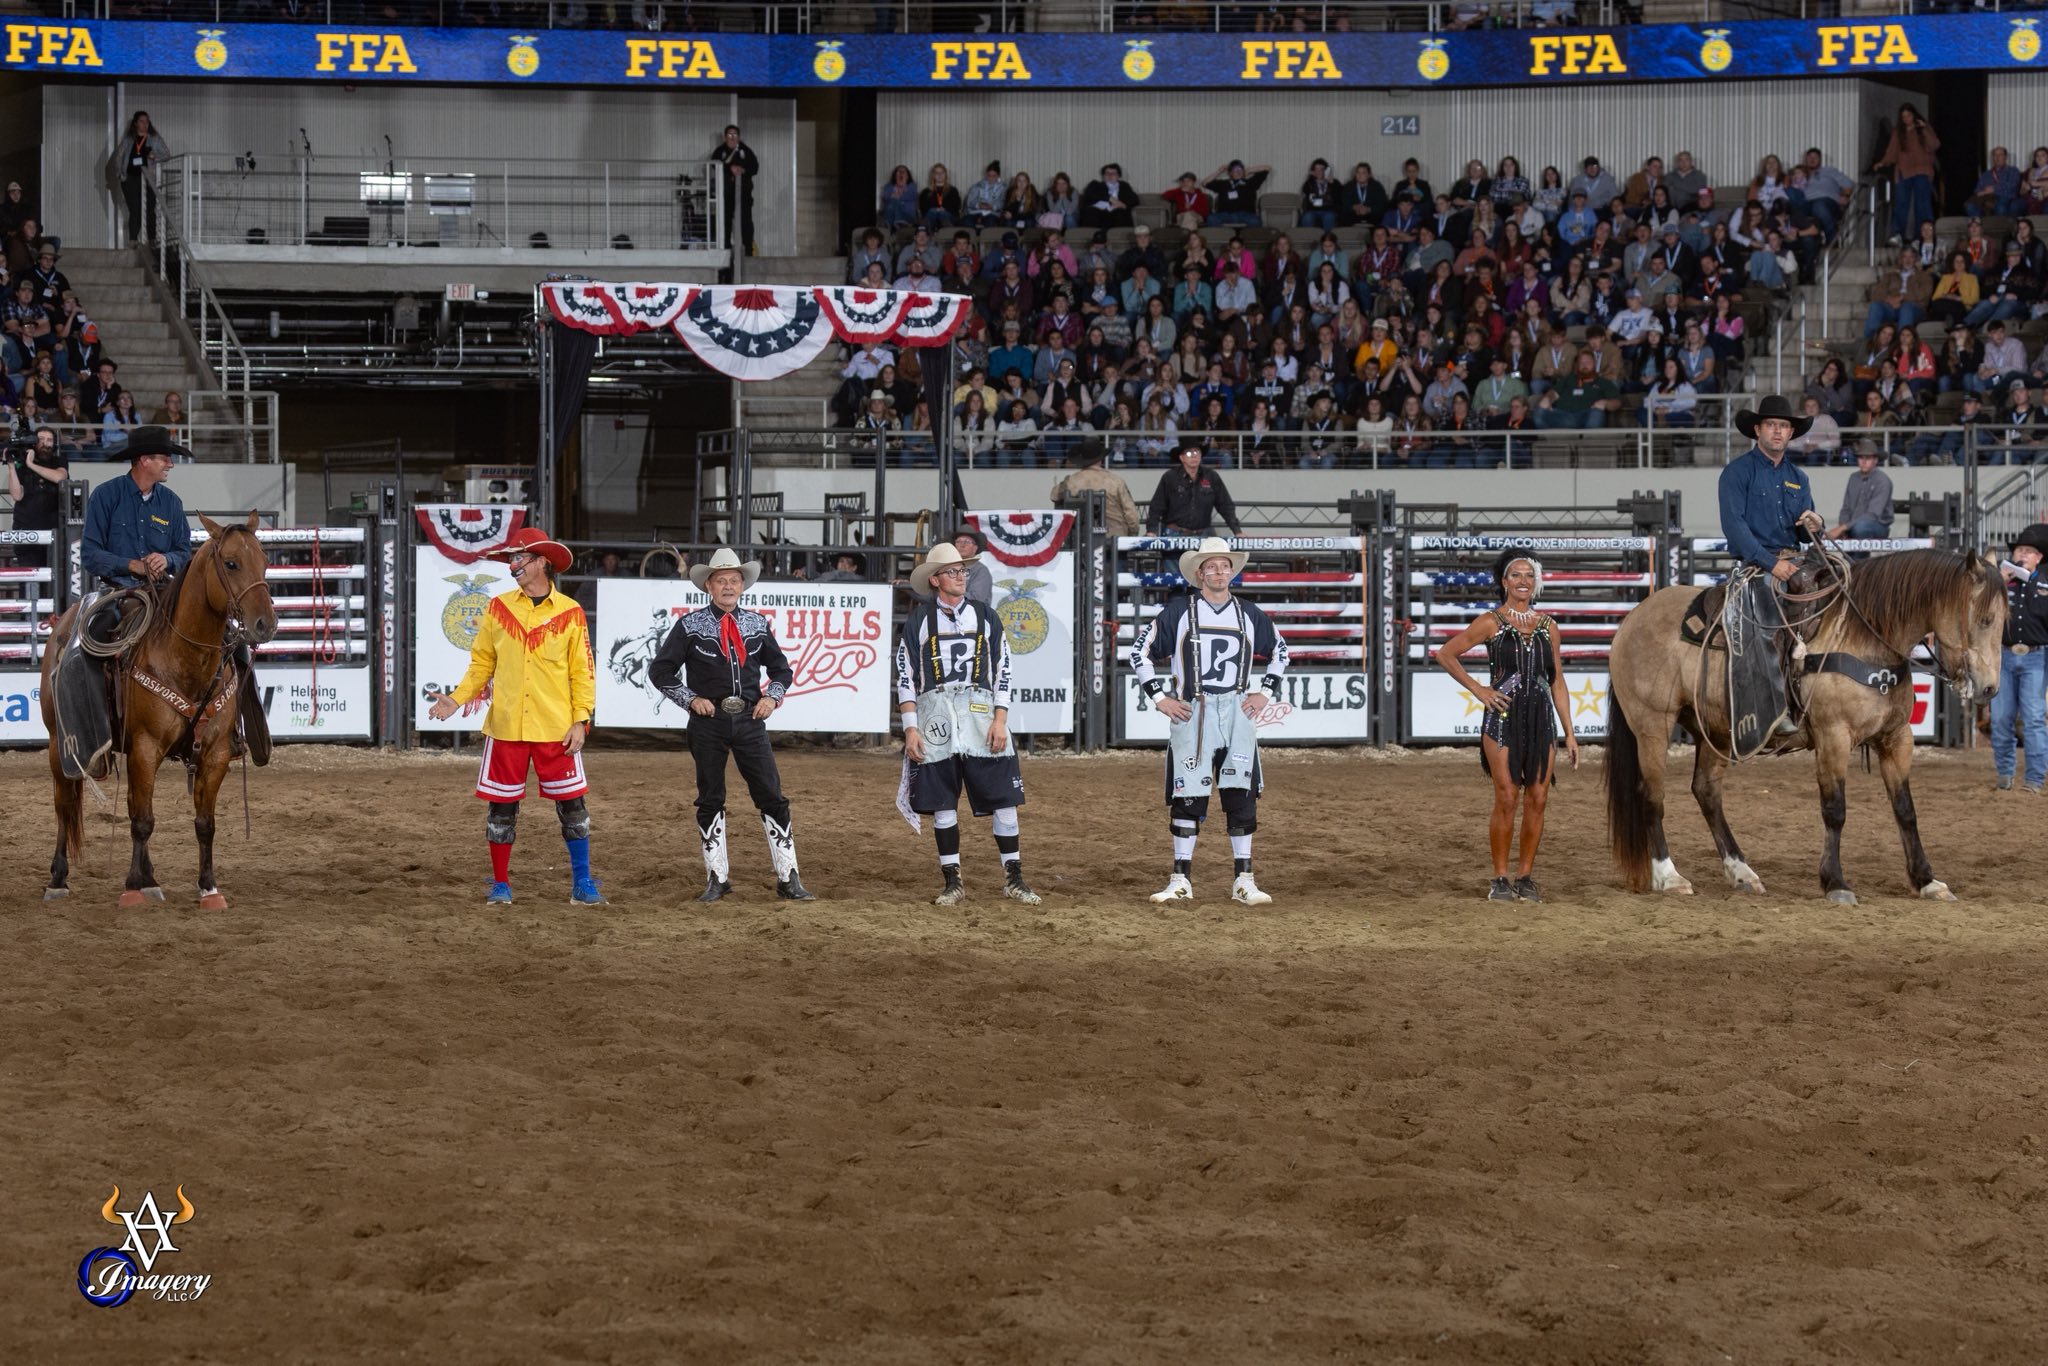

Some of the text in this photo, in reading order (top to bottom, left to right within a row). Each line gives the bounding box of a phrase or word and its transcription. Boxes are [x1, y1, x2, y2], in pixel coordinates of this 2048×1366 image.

[6, 25, 101, 65] FFA
[316, 34, 417, 72] FFA
[1818, 25, 1917, 66] FFA
[626, 40, 726, 79] FFA
[932, 43, 1031, 79] FFA
[1242, 41, 1342, 79] FFA
[1531, 35, 1627, 75] FFA
[1383, 116, 1417, 134] 214
[452, 284, 470, 298] EXIT
[1, 531, 39, 543] EXPO
[1167, 537, 1335, 550] THR HILLS RODEO
[1424, 537, 1487, 549] NATIONAL
[1489, 537, 1512, 549] FFA
[1515, 537, 1597, 549] CONVENTION
[1611, 537, 1644, 549] EXPO
[1851, 539, 1903, 551] RODEO
[686, 592, 712, 605] NATI
[762, 594, 824, 607] CONVENTION
[829, 595, 836, 607] &
[840, 596, 867, 608] EXPO
[461, 607, 484, 616] FFA
[1009, 612, 1031, 620] FFA
[786, 610, 882, 641] HILLS
[384, 603, 395, 693] RODEO
[1093, 606, 1104, 695] RODEO
[1383, 605, 1393, 693] RODEO
[291, 685, 337, 699] Helping
[1020, 688, 1067, 703] BARN
[290, 700, 310, 712] the
[1454, 725, 1471, 734] U.S.
